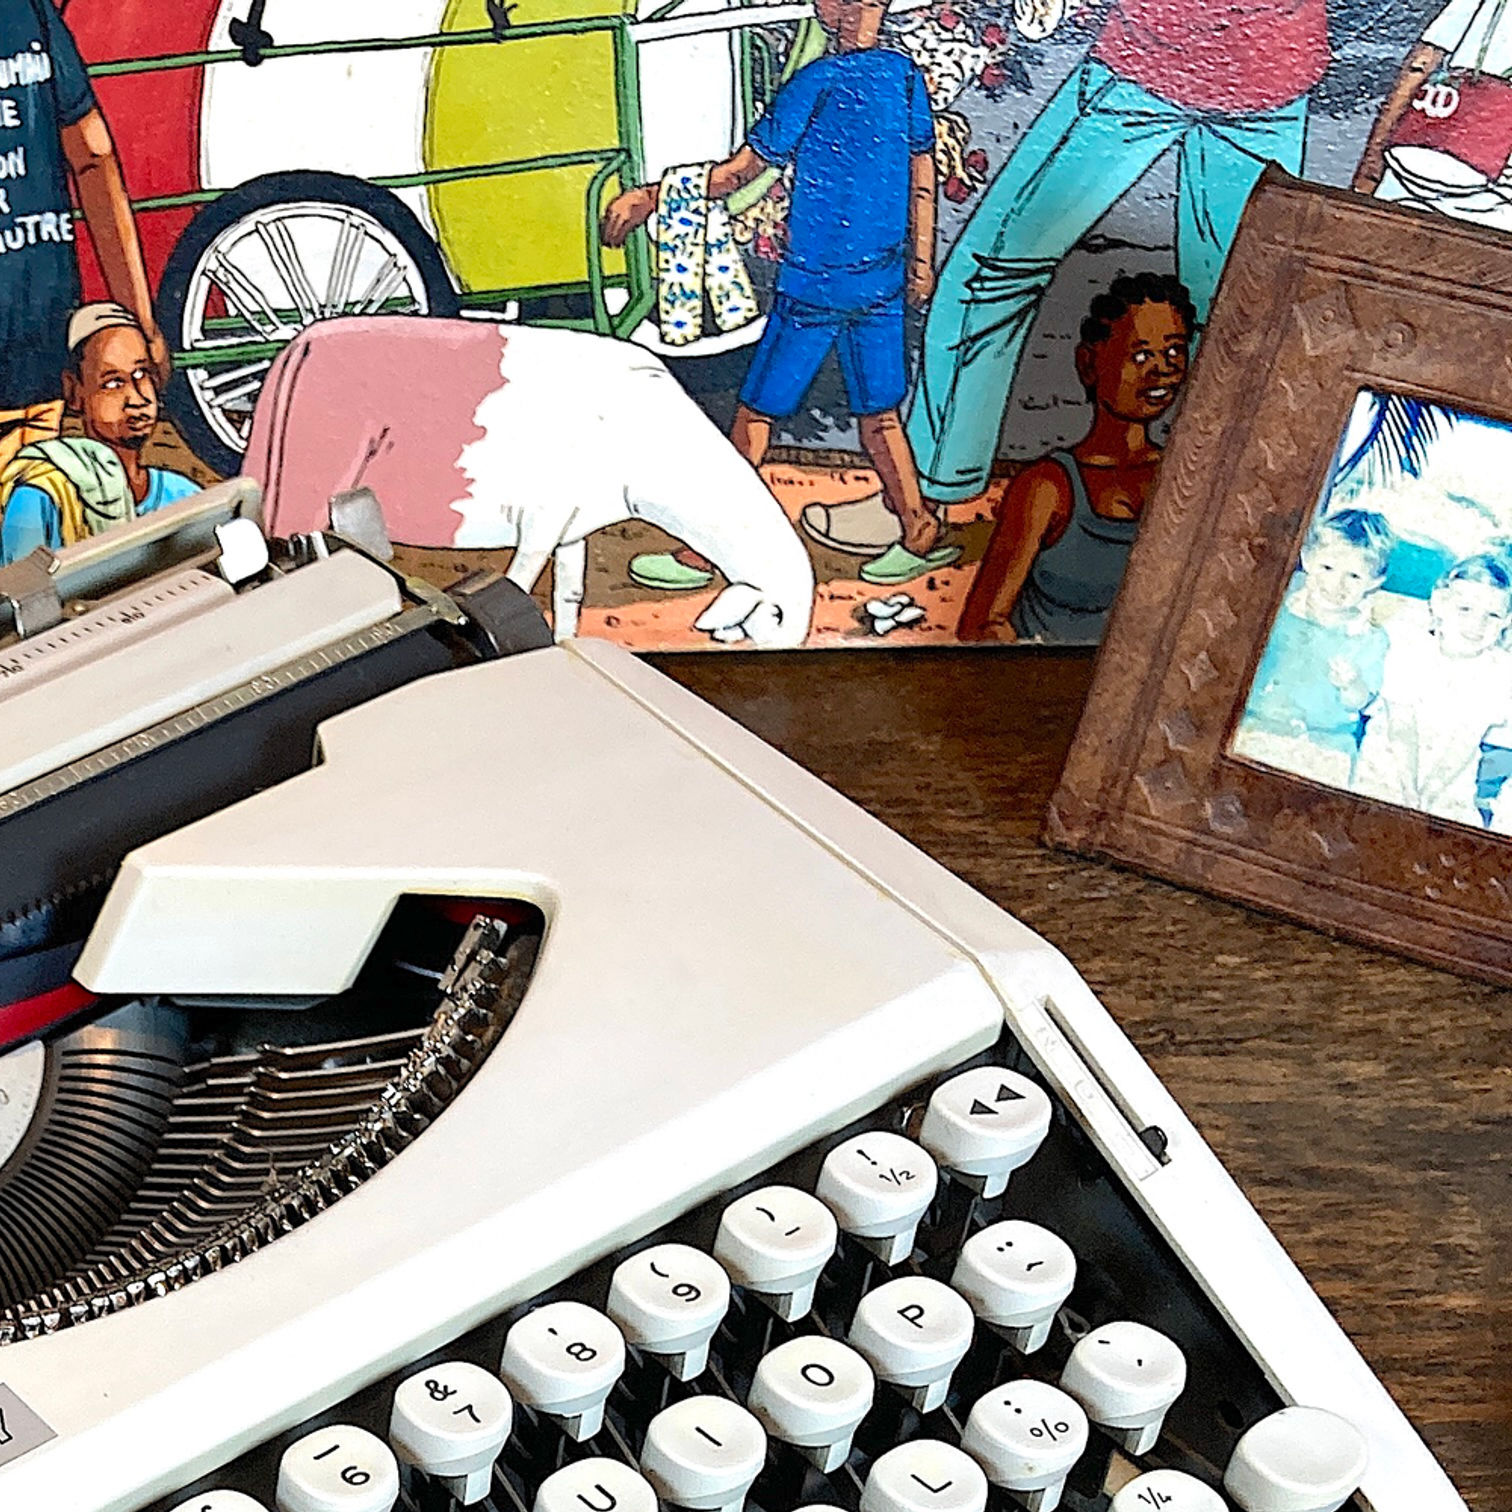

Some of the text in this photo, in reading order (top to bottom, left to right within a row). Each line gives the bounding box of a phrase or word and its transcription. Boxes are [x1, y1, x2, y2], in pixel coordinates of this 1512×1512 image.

[856, 1149, 878, 1166] !
[671, 1283, 702, 1303] 9
[896, 1304, 925, 1329] P
[565, 1342, 598, 1362] 8
[800, 1363, 835, 1387] O
[424, 1379, 458, 1402] &
[452, 1403, 482, 1424] 7
[694, 1426, 723, 1447] I
[1029, 1418, 1070, 1442] %
[340, 1465, 371, 1486] 6
[910, 1473, 953, 1494] L
[576, 1483, 617, 1512] U
